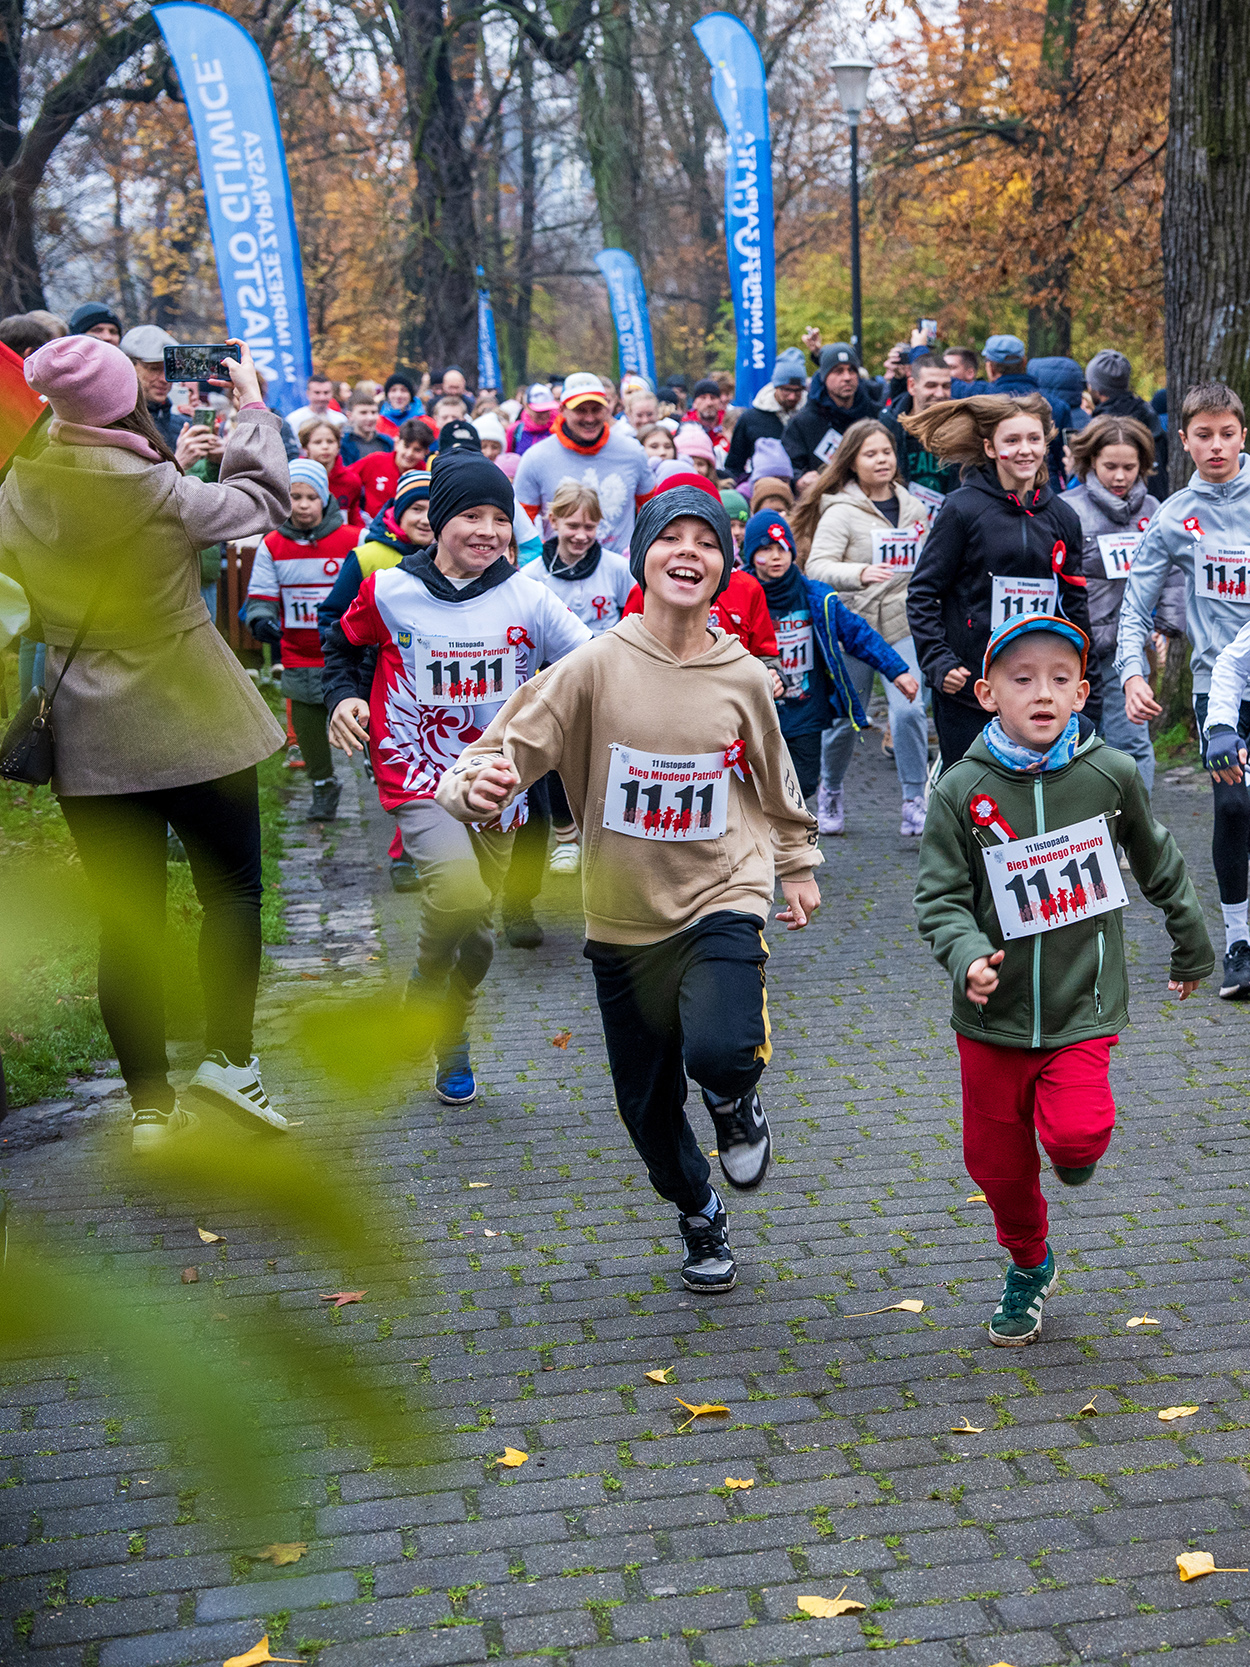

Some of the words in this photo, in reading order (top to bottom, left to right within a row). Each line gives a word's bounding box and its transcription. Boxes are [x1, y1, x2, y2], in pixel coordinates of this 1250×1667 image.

[455, 641, 485, 649] listopada
[431, 650, 448, 659] Bieg
[449, 650, 481, 658] Młodego
[483, 648, 510, 657] Patrioty
[660, 760, 695, 769] listopada
[628, 765, 649, 779] Bieg
[650, 770, 691, 782] Młodego
[692, 770, 723, 782] Patrioty
[1025, 845, 1033, 854] 11
[1034, 834, 1070, 852] listopada
[1006, 858, 1029, 872] Bieg
[1028, 848, 1070, 867] Młodego
[1070, 836, 1103, 855] Patrioty
